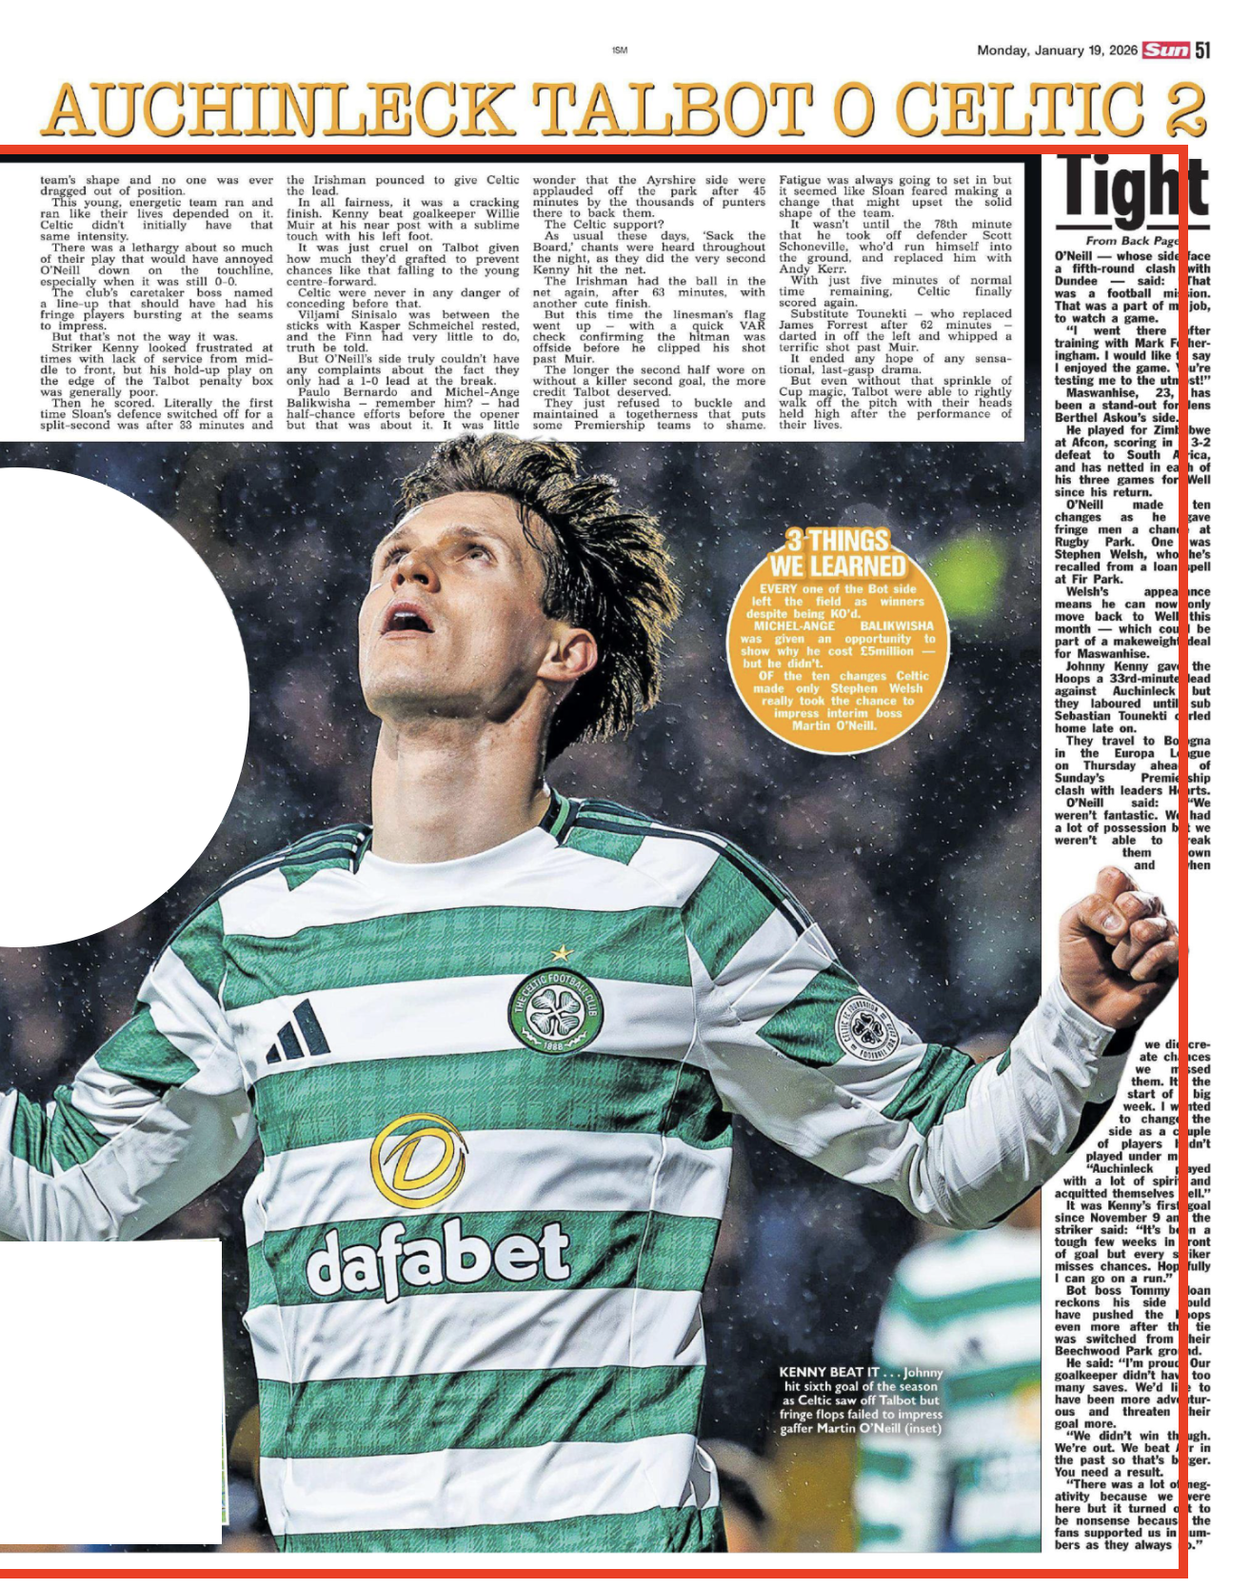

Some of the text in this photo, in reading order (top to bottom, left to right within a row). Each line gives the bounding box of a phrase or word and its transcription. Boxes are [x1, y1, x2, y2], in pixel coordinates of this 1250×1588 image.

[978, 42, 1210, 59] Monday, January 19, 2026 Sun 51
[40, 82, 517, 138] AUCHINLECK
[533, 82, 813, 138] TALBOT
[896, 82, 1144, 138] CELTIC
[1167, 82, 1207, 138] 2
[1057, 154, 1209, 230] Tight
[286, 208, 519, 222] finish. Kenny beat goalkeeper Willie
[1087, 236, 1148, 245] From Back
[41, 266, 79, 274] O'Neill
[99, 265, 129, 275] down
[181, 266, 198, 274] the
[218, 265, 273, 275] touchline,
[534, 265, 645, 276] Kenny hit the net.
[780, 264, 846, 276] Andy Kerr.
[788, 530, 889, 552] 3 THINGS
[770, 555, 906, 577] WE LEARNED
[761, 584, 797, 593] EVERY
[829, 584, 839, 593] of
[845, 585, 863, 593] the
[869, 584, 888, 593] Bot
[894, 584, 916, 593] side
[754, 621, 934, 631] MICHEL-ANGE BALIKWISHA
[515, 974, 598, 1017] THE CELTIC FOOTBALL CLUB
[1067, 1201, 1074, 1210] It
[1108, 1201, 1151, 1212] Kenny's
[306, 1218, 570, 1303] dafabet
[1056, 1346, 1152, 1355] Beechwood Park
[781, 1409, 943, 1422] fringe flops failed to impress
[780, 1423, 942, 1436] gaffer Martin O'Neill (inset)
[1055, 1467, 1075, 1477] You
[1081, 1467, 1109, 1477] need
[1128, 1467, 1163, 1477] result.
